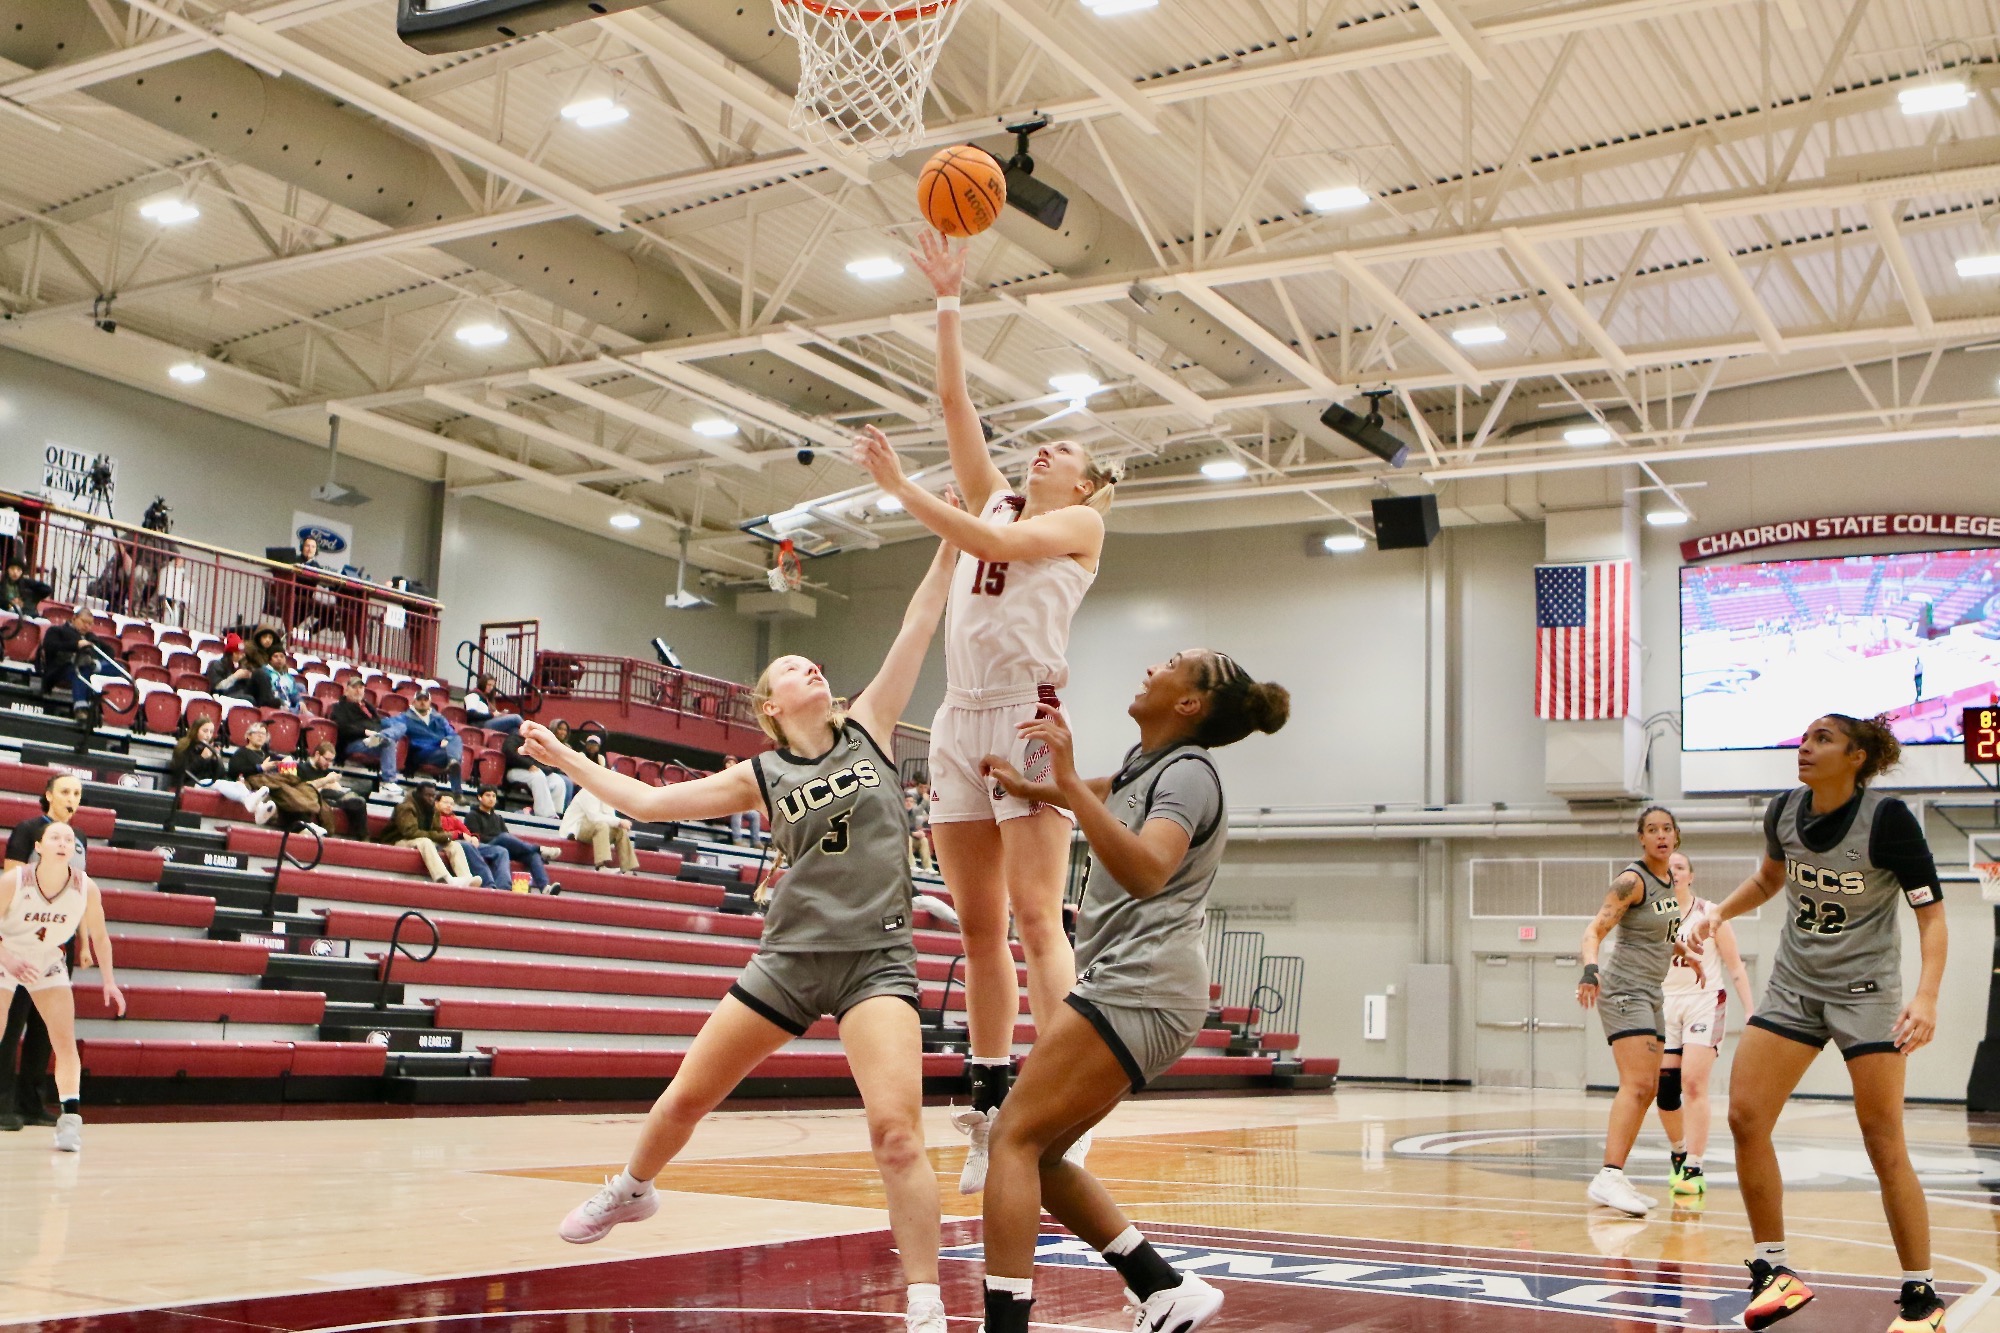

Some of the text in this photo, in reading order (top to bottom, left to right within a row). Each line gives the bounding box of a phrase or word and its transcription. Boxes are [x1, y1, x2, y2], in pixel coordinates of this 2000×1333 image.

[310, 529, 338, 550] Ford
[1697, 514, 2000, 555] CHADRON STATE COLLEGE
[971, 560, 1009, 596] 15
[776, 759, 881, 825] UCCS
[23, 911, 67, 924] EAGLES
[1795, 894, 1847, 935] 22
[35, 926, 47, 942] 4
